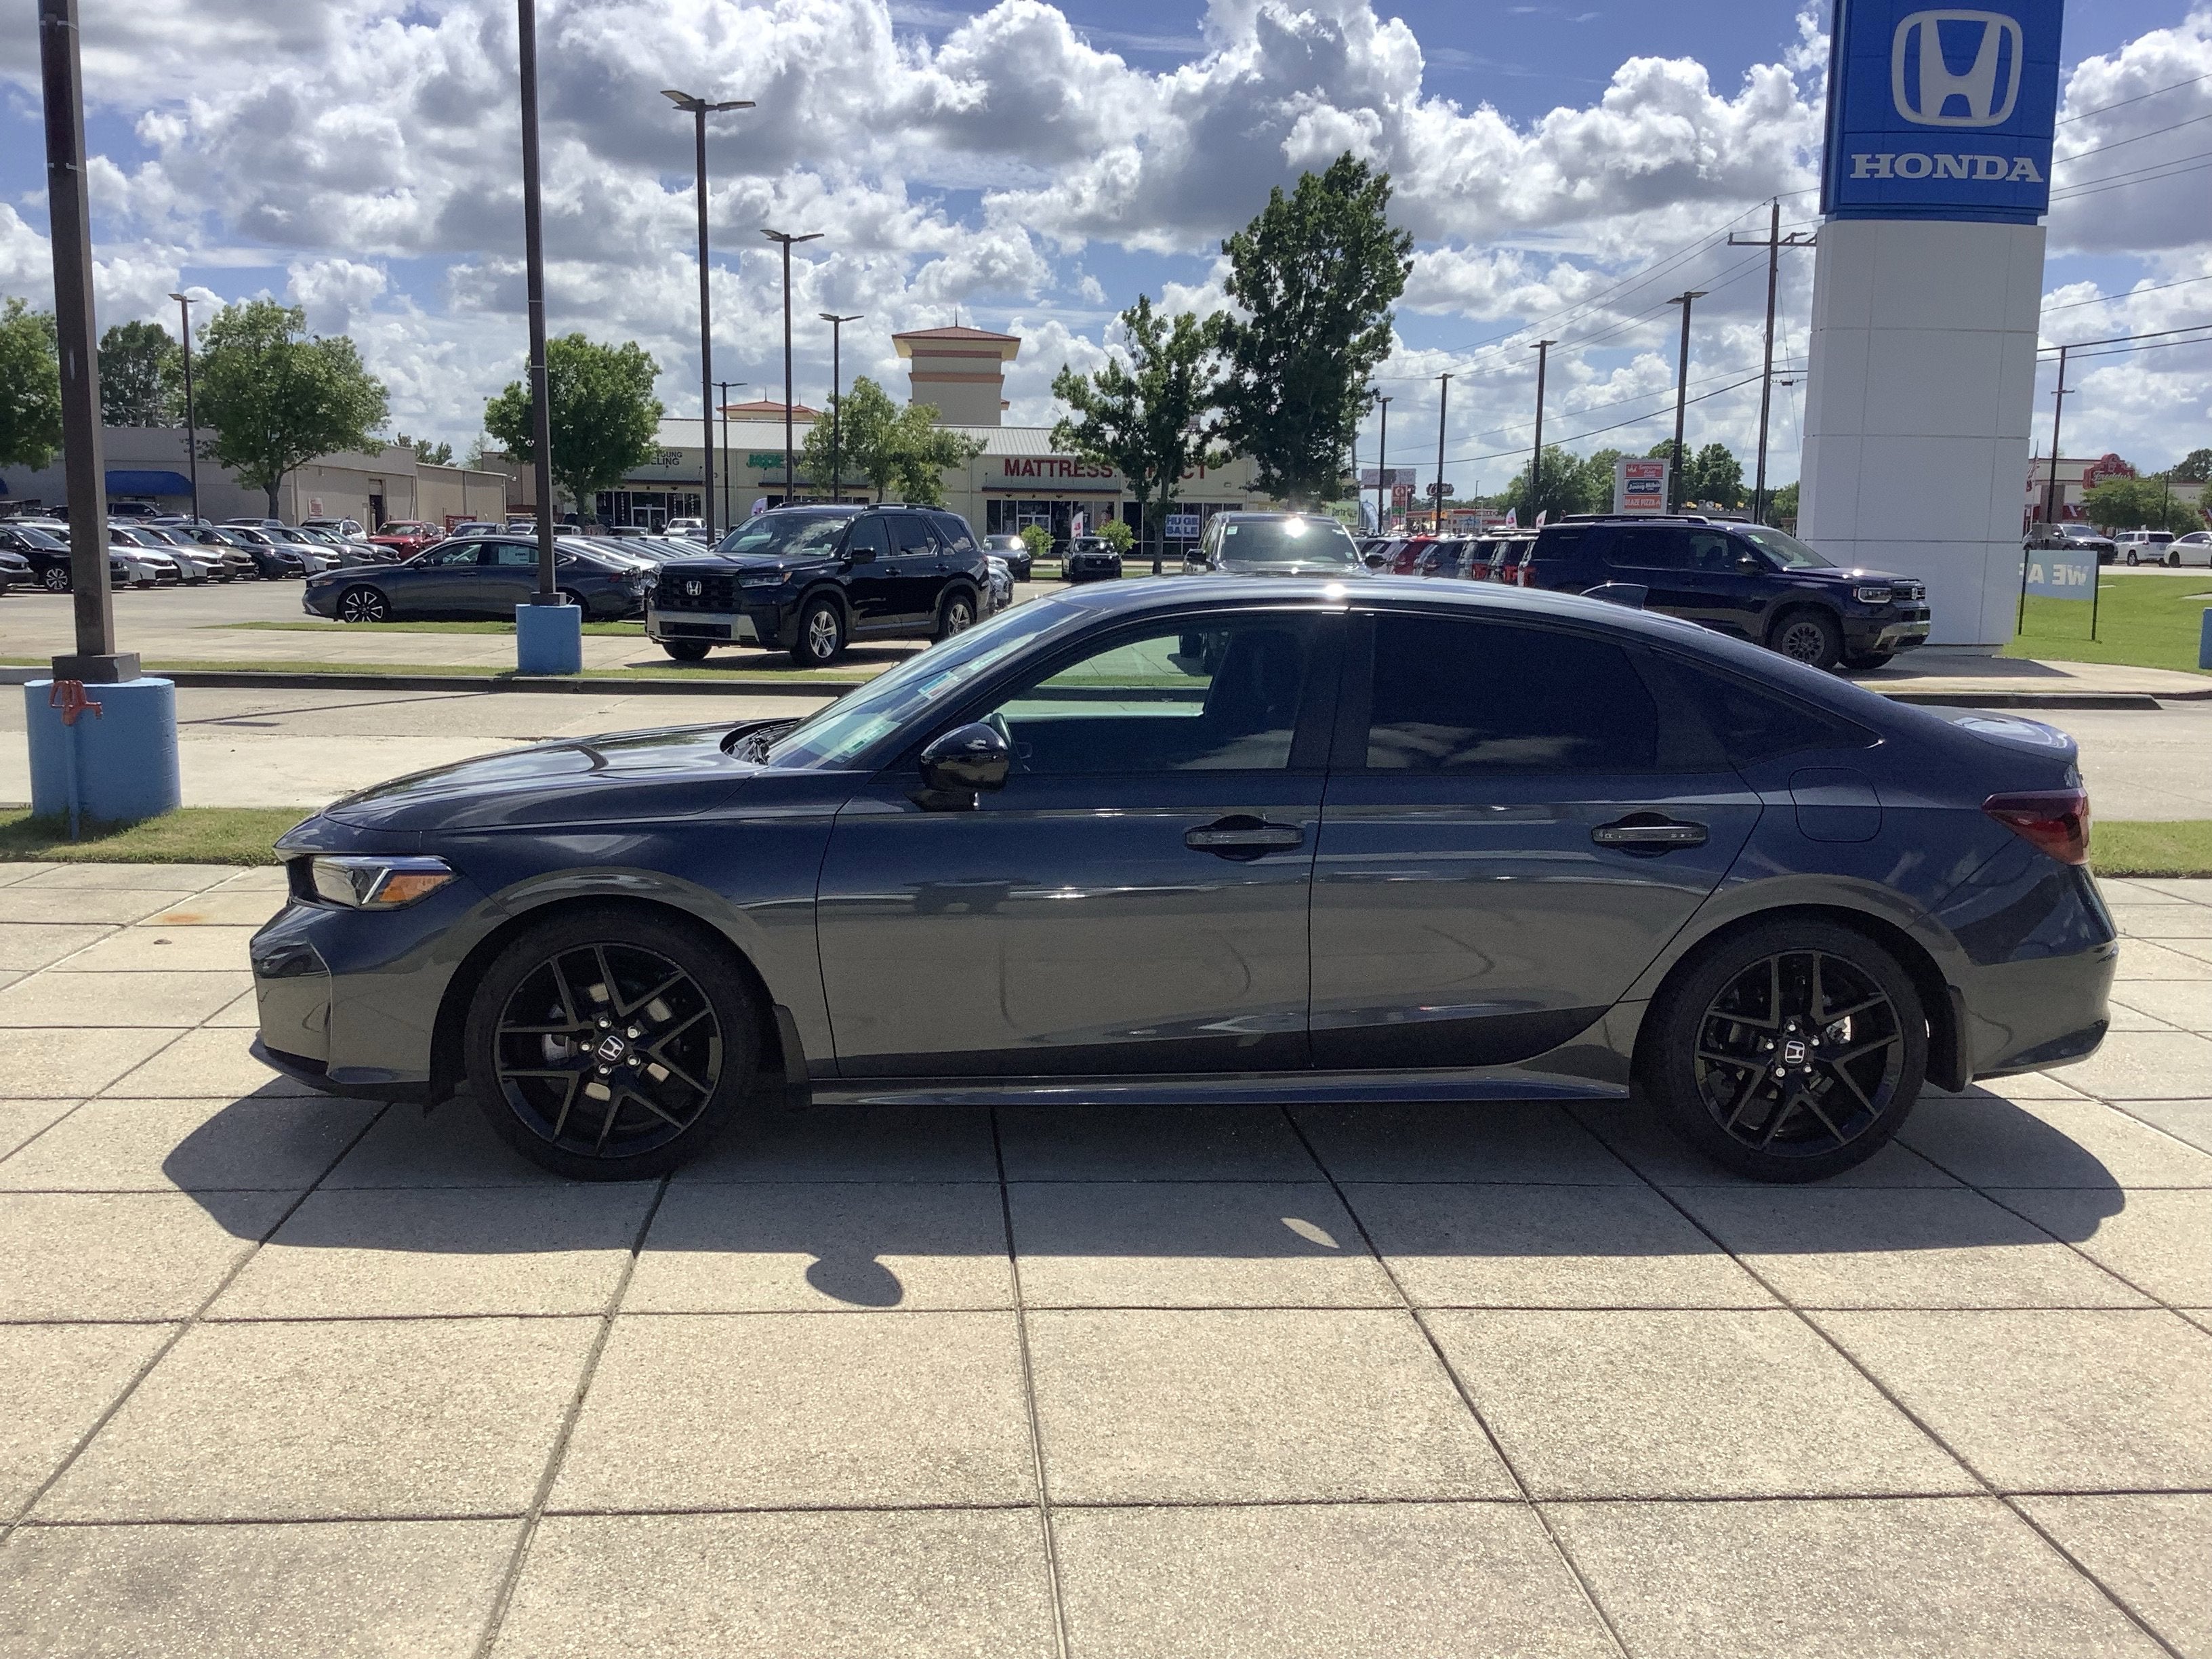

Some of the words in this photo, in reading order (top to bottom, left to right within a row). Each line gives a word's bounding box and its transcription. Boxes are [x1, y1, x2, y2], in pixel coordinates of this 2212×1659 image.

[1849, 152, 2044, 183] HONDA
[1004, 458, 1113, 478] MATTRESS
[1166, 516, 1198, 525] HUGE
[1166, 526, 1197, 534] SALE
